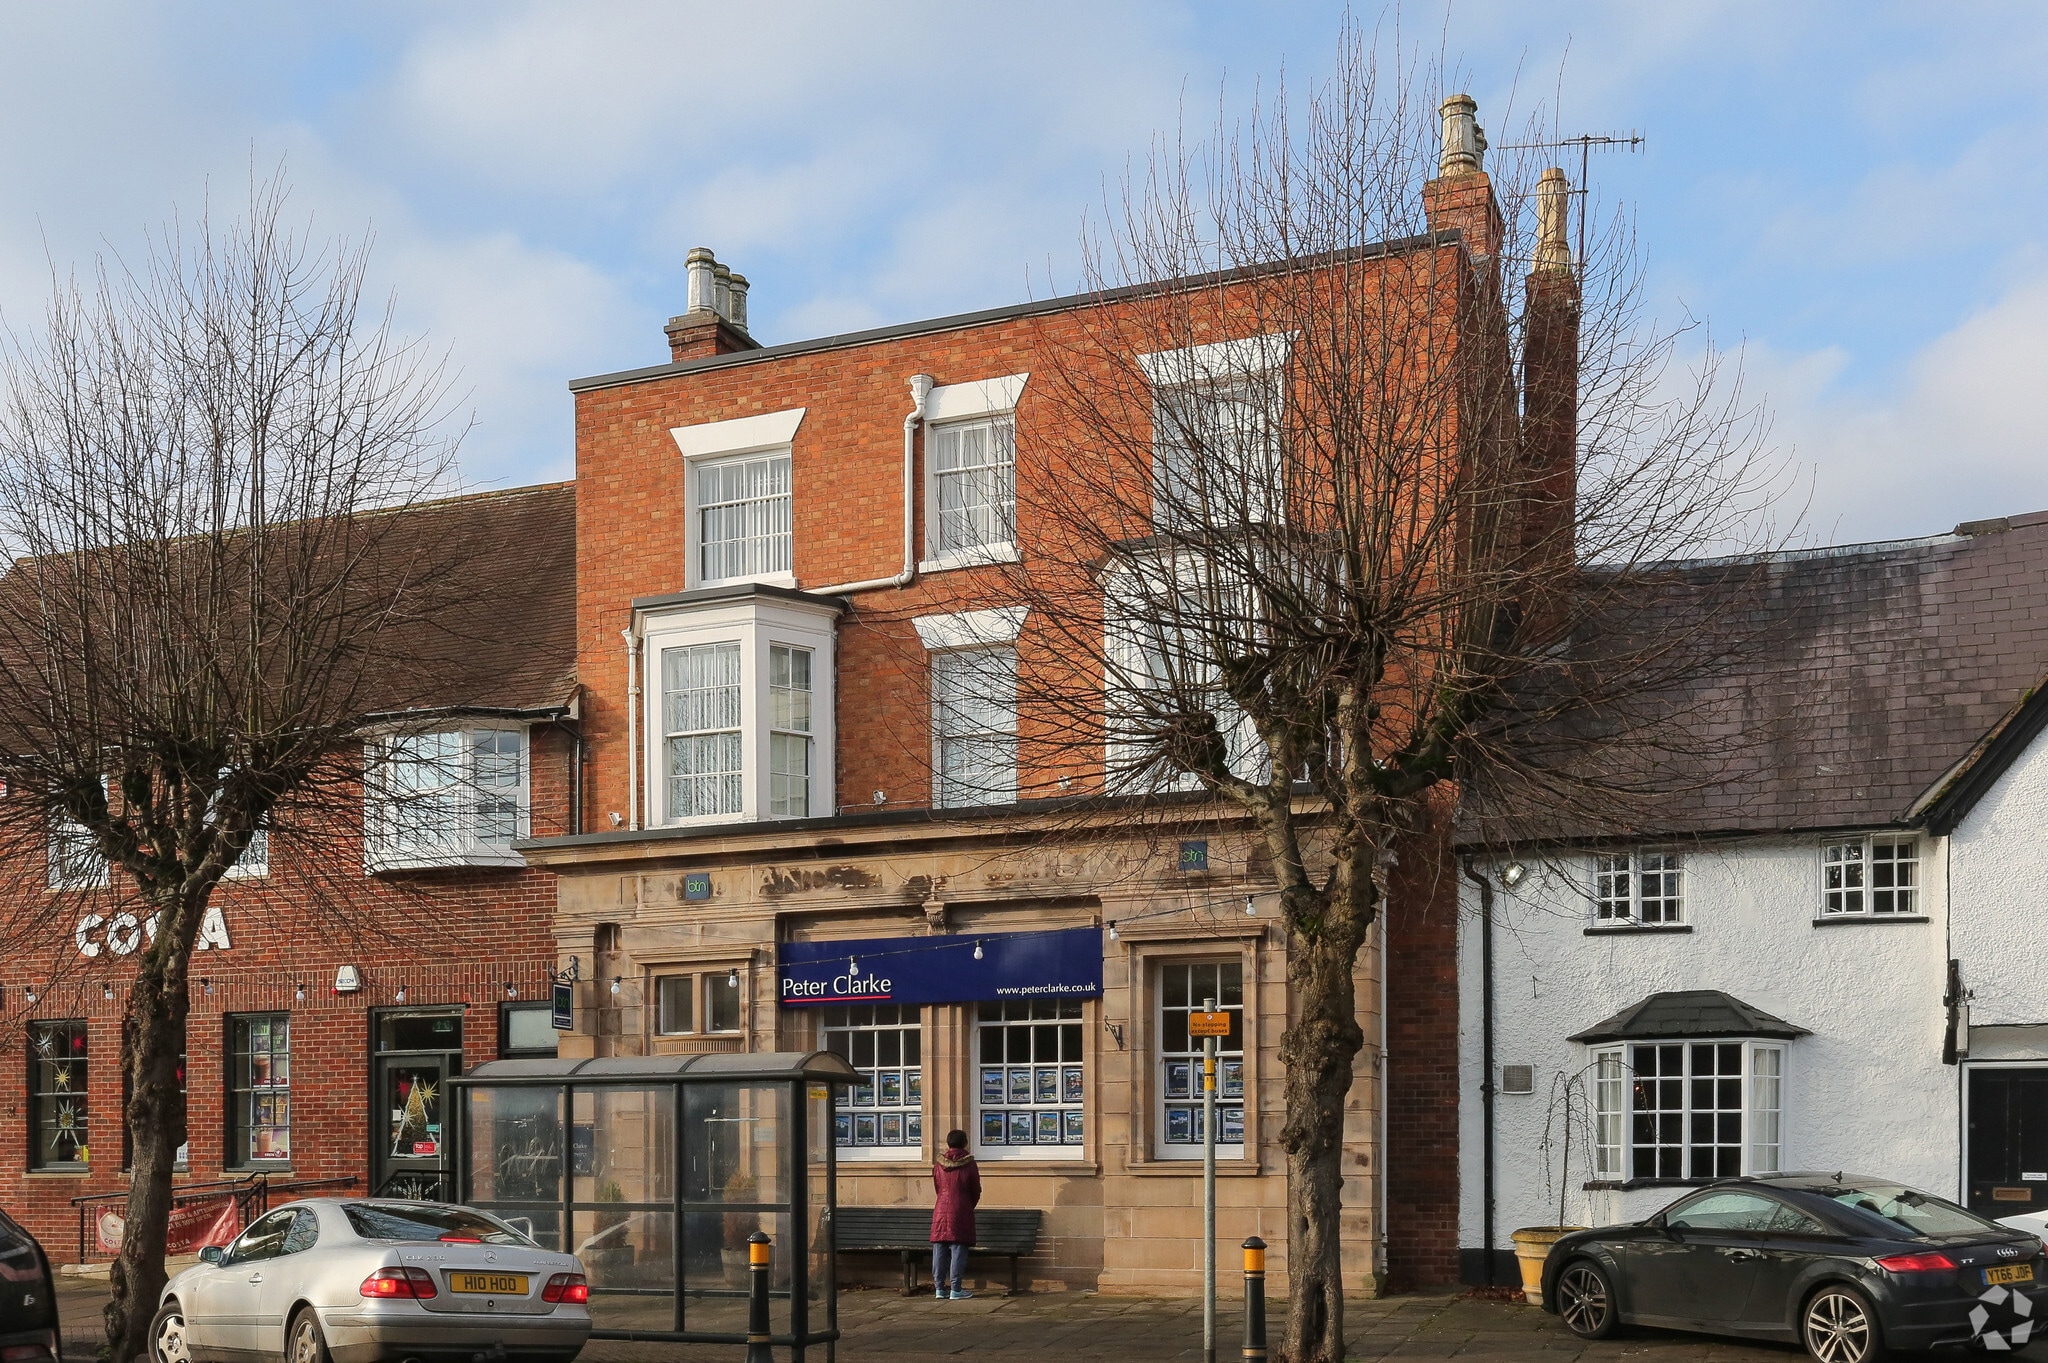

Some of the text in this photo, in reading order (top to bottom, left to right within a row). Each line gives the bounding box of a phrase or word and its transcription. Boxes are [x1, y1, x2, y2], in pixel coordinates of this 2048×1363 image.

[687, 879, 707, 892] btn
[75, 907, 231, 957] COA
[783, 973, 892, 996] Peter Clarke
[996, 982, 1096, 996] www.peterclarke.co.uk
[1987, 1266, 2032, 1282] YT66 JDF
